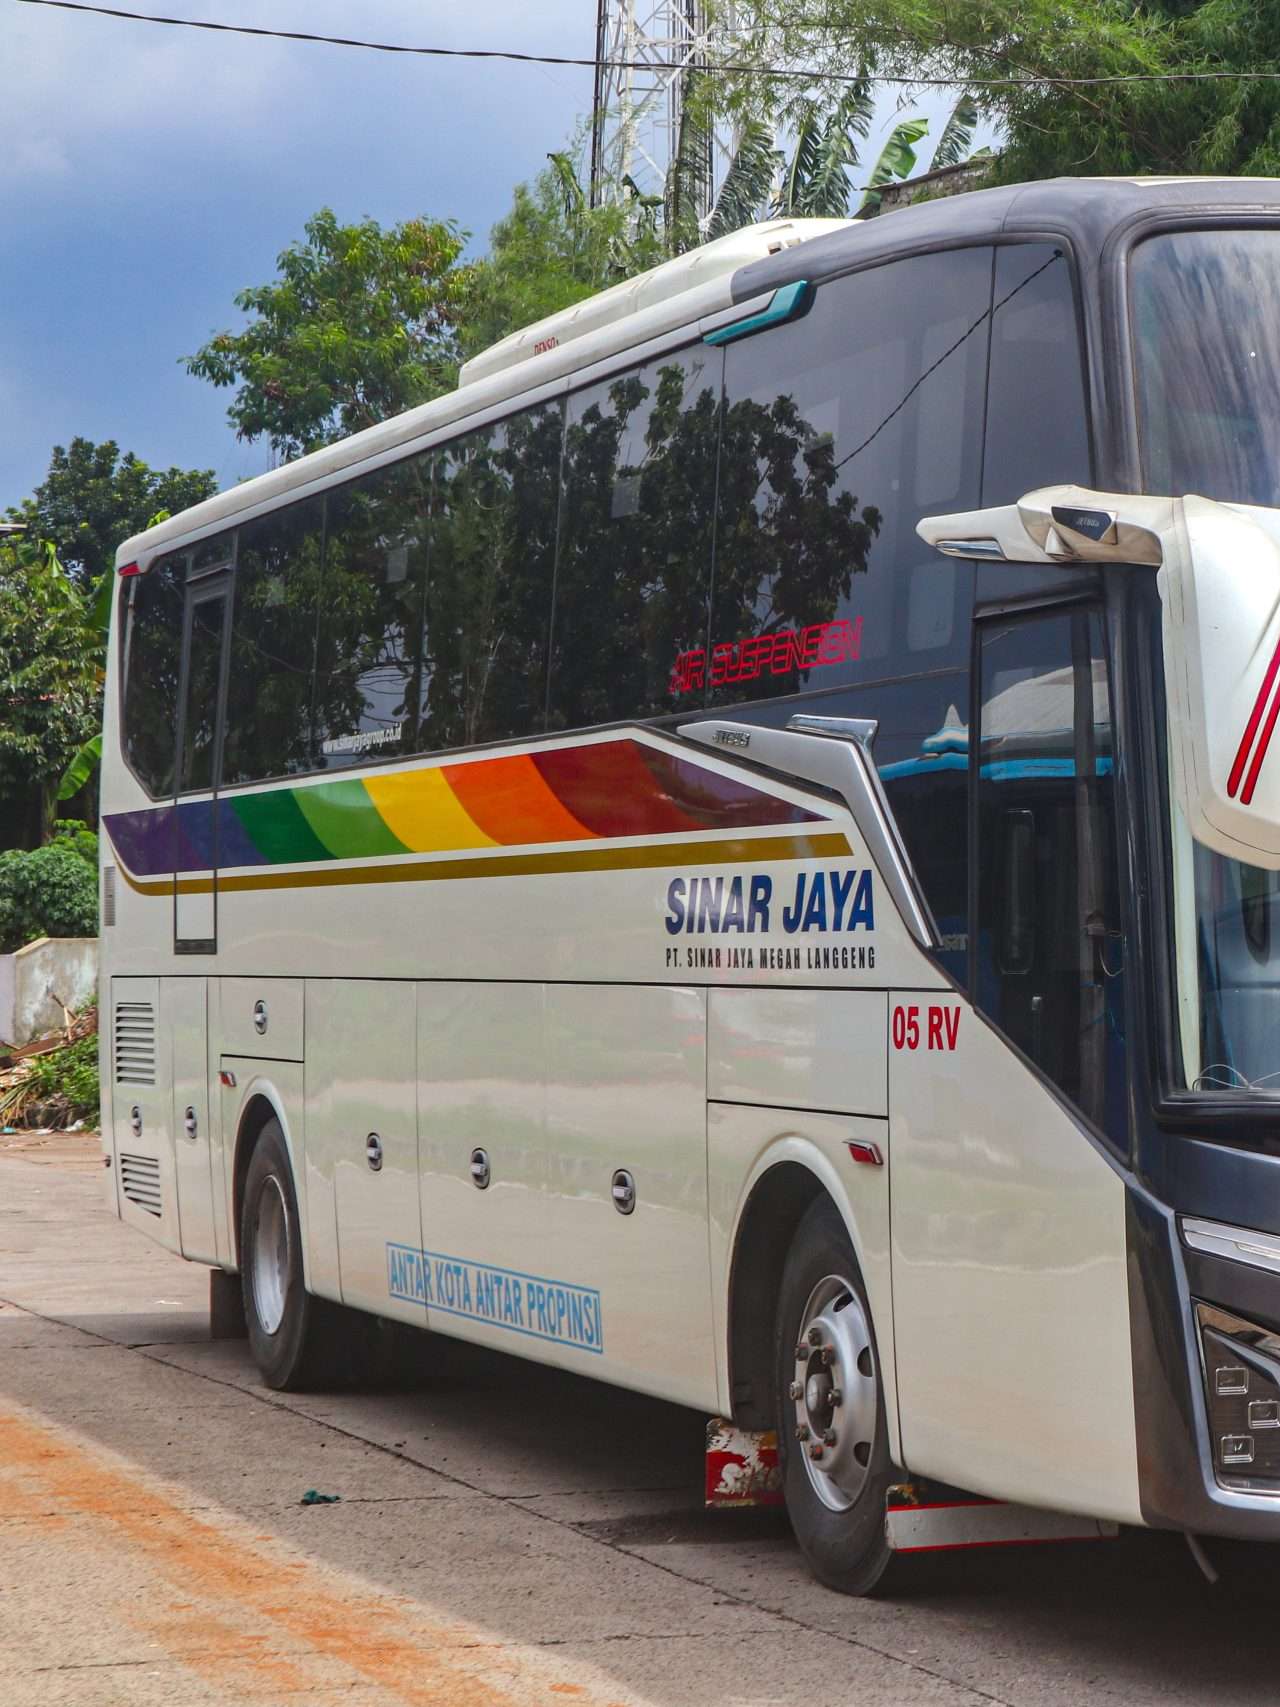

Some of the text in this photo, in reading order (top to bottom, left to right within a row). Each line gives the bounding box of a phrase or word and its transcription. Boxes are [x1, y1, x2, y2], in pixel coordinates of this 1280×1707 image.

[668, 615, 864, 694] AIR SUSPENSION
[664, 868, 875, 935] SINAR JAYA
[666, 946, 875, 970] PT. SINAR JAYA MEGAH LANGGENG
[892, 1005, 961, 1051] 05 RV
[390, 1249, 600, 1346] ANTAR KOTA ANTAR PROPINSI
